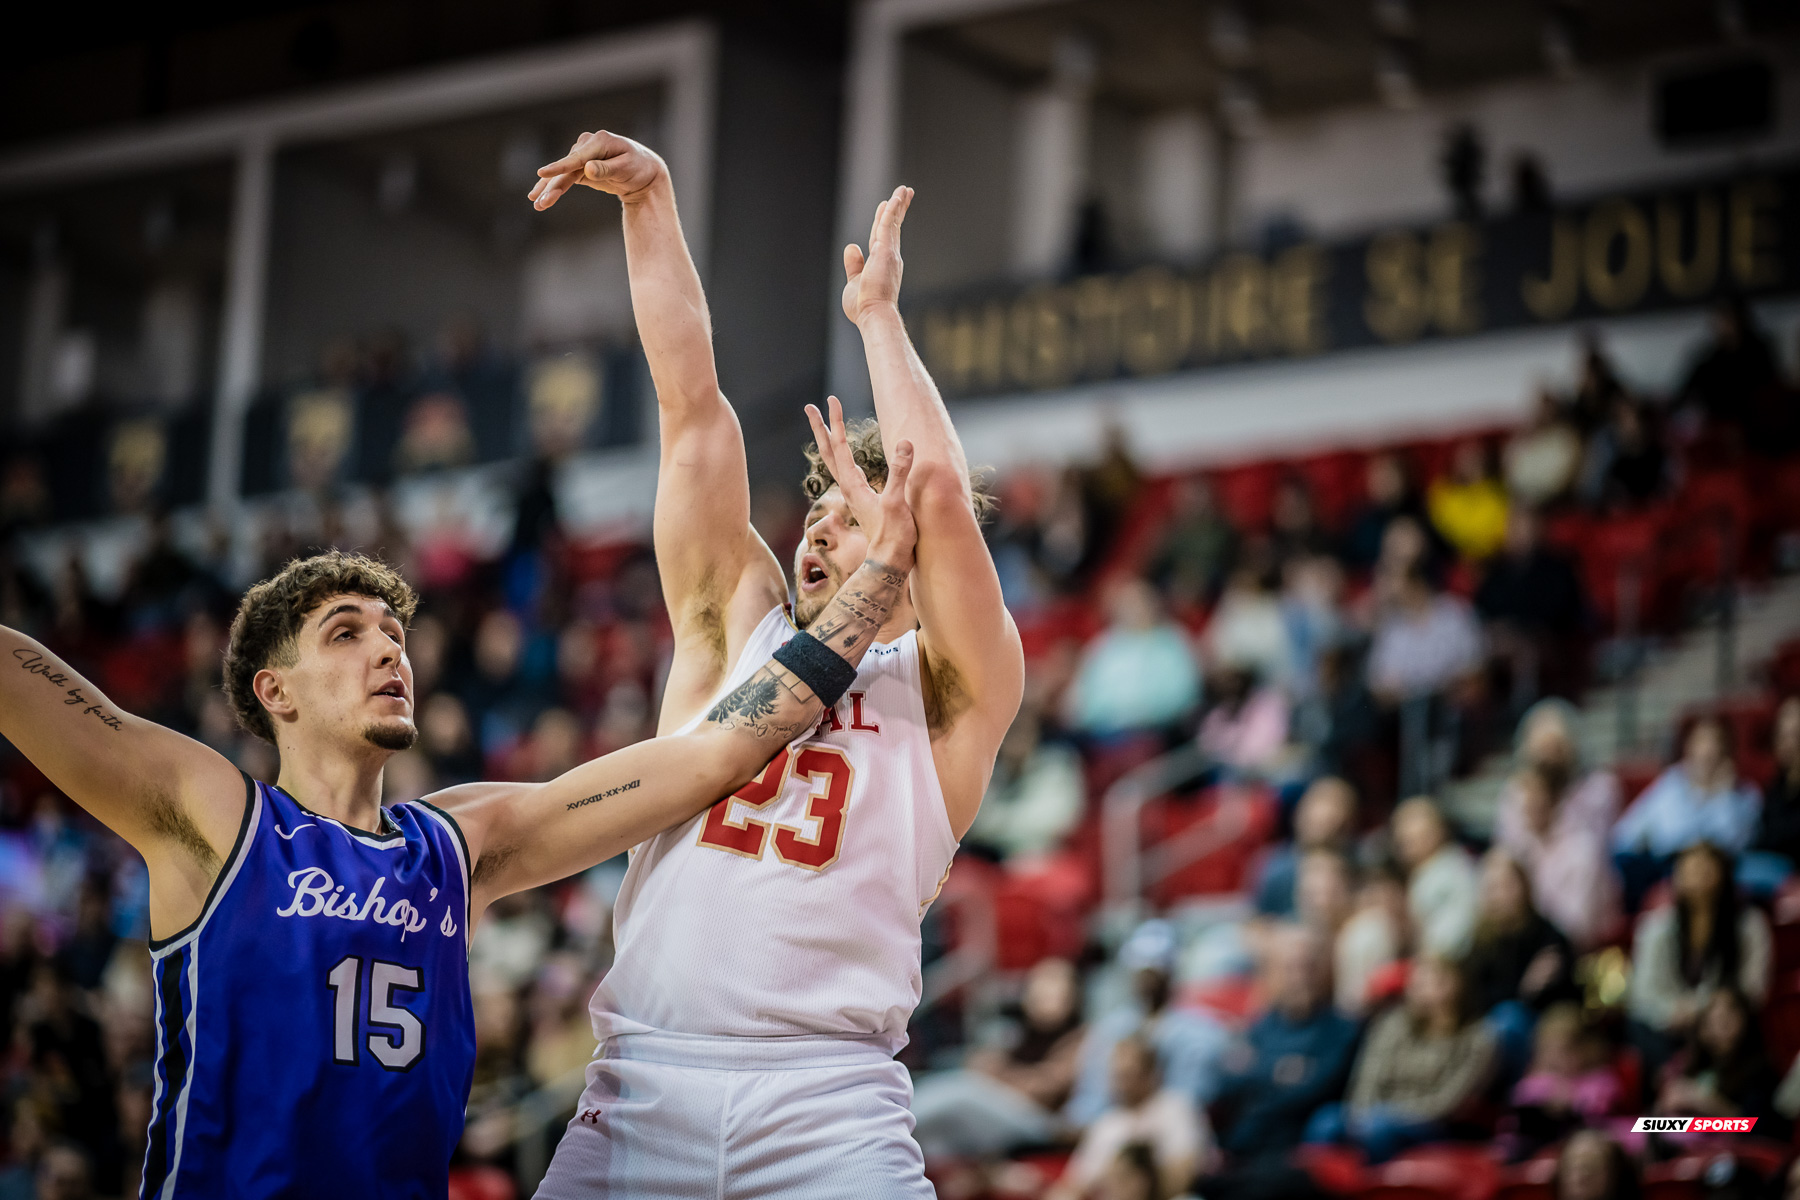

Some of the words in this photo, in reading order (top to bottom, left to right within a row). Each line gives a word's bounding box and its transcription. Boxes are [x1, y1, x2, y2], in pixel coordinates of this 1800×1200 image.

[1364, 225, 1480, 344] SE
[1520, 180, 1780, 317] JOUE
[13, 649, 68, 687] Walk
[64, 689, 88, 705] by
[83, 705, 122, 731] faith
[696, 743, 856, 872] 23
[276, 866, 458, 943] Bishop's
[325, 953, 427, 1074] 15
